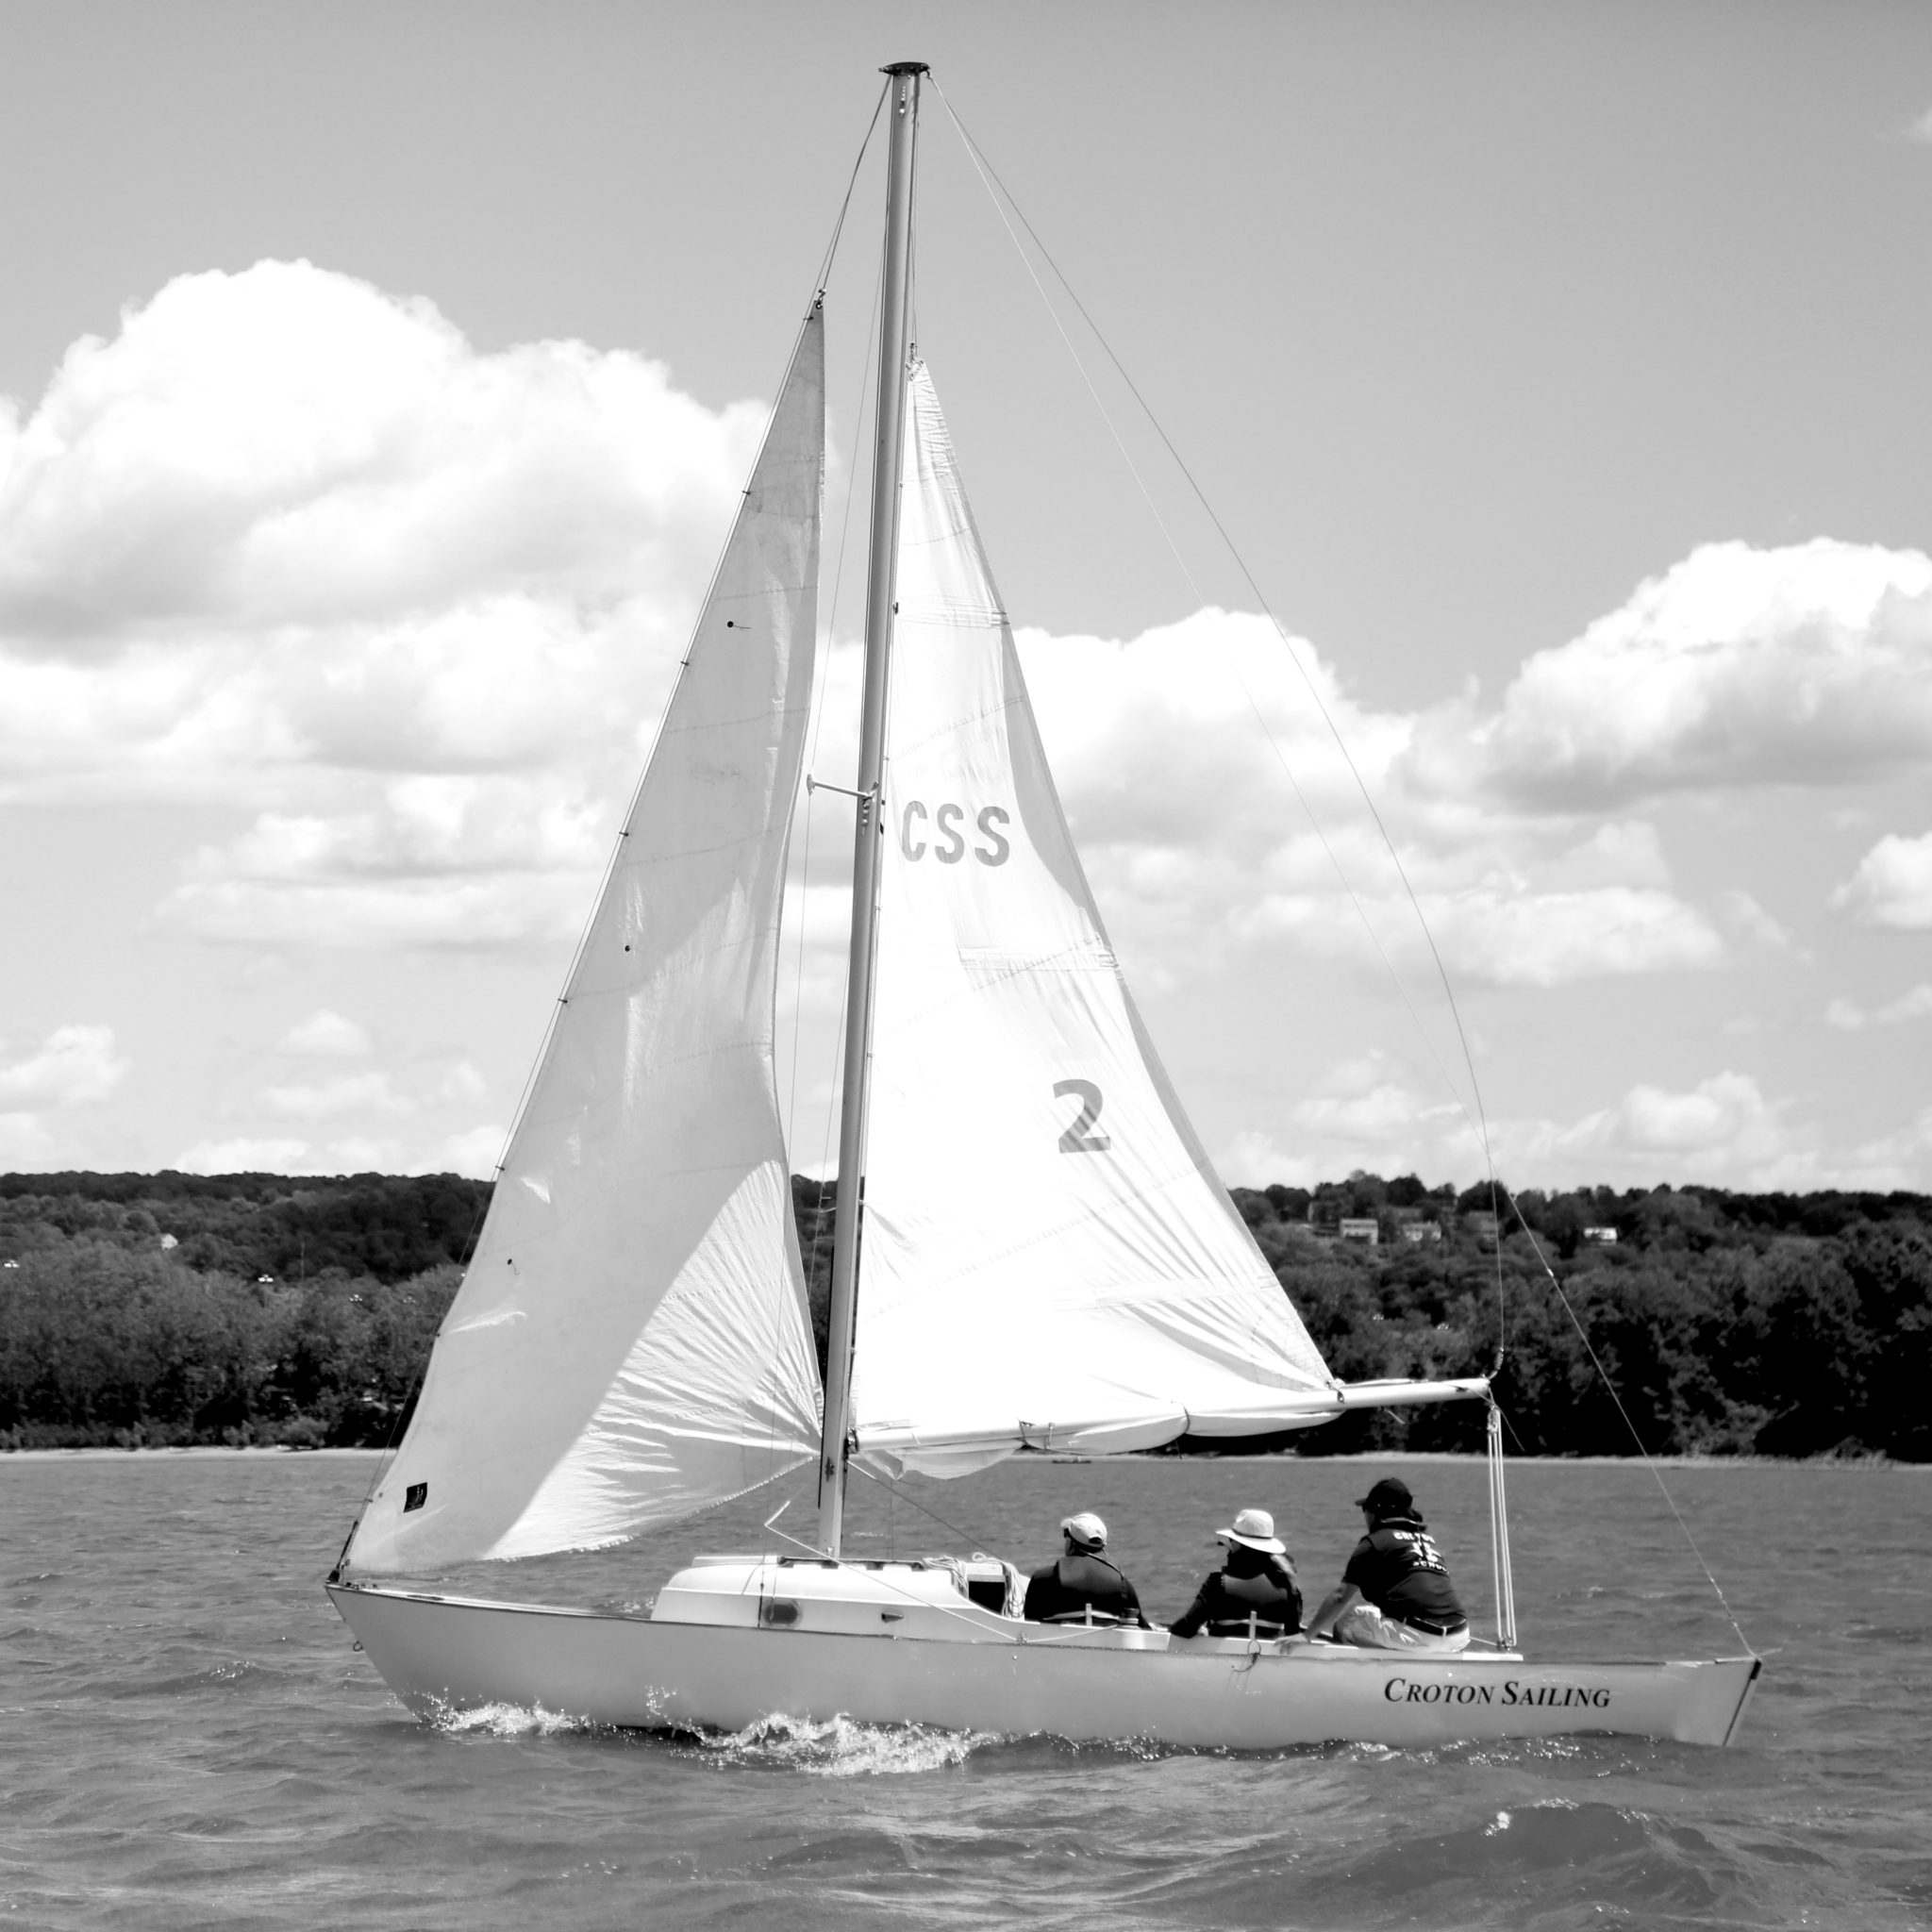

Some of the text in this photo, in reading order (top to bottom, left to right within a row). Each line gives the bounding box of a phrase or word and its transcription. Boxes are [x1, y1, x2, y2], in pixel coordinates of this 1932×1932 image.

[902, 800, 1009, 867] CSS
[1053, 1078, 1111, 1154] 2
[1384, 1677, 1611, 1708] CROTON SAILING
